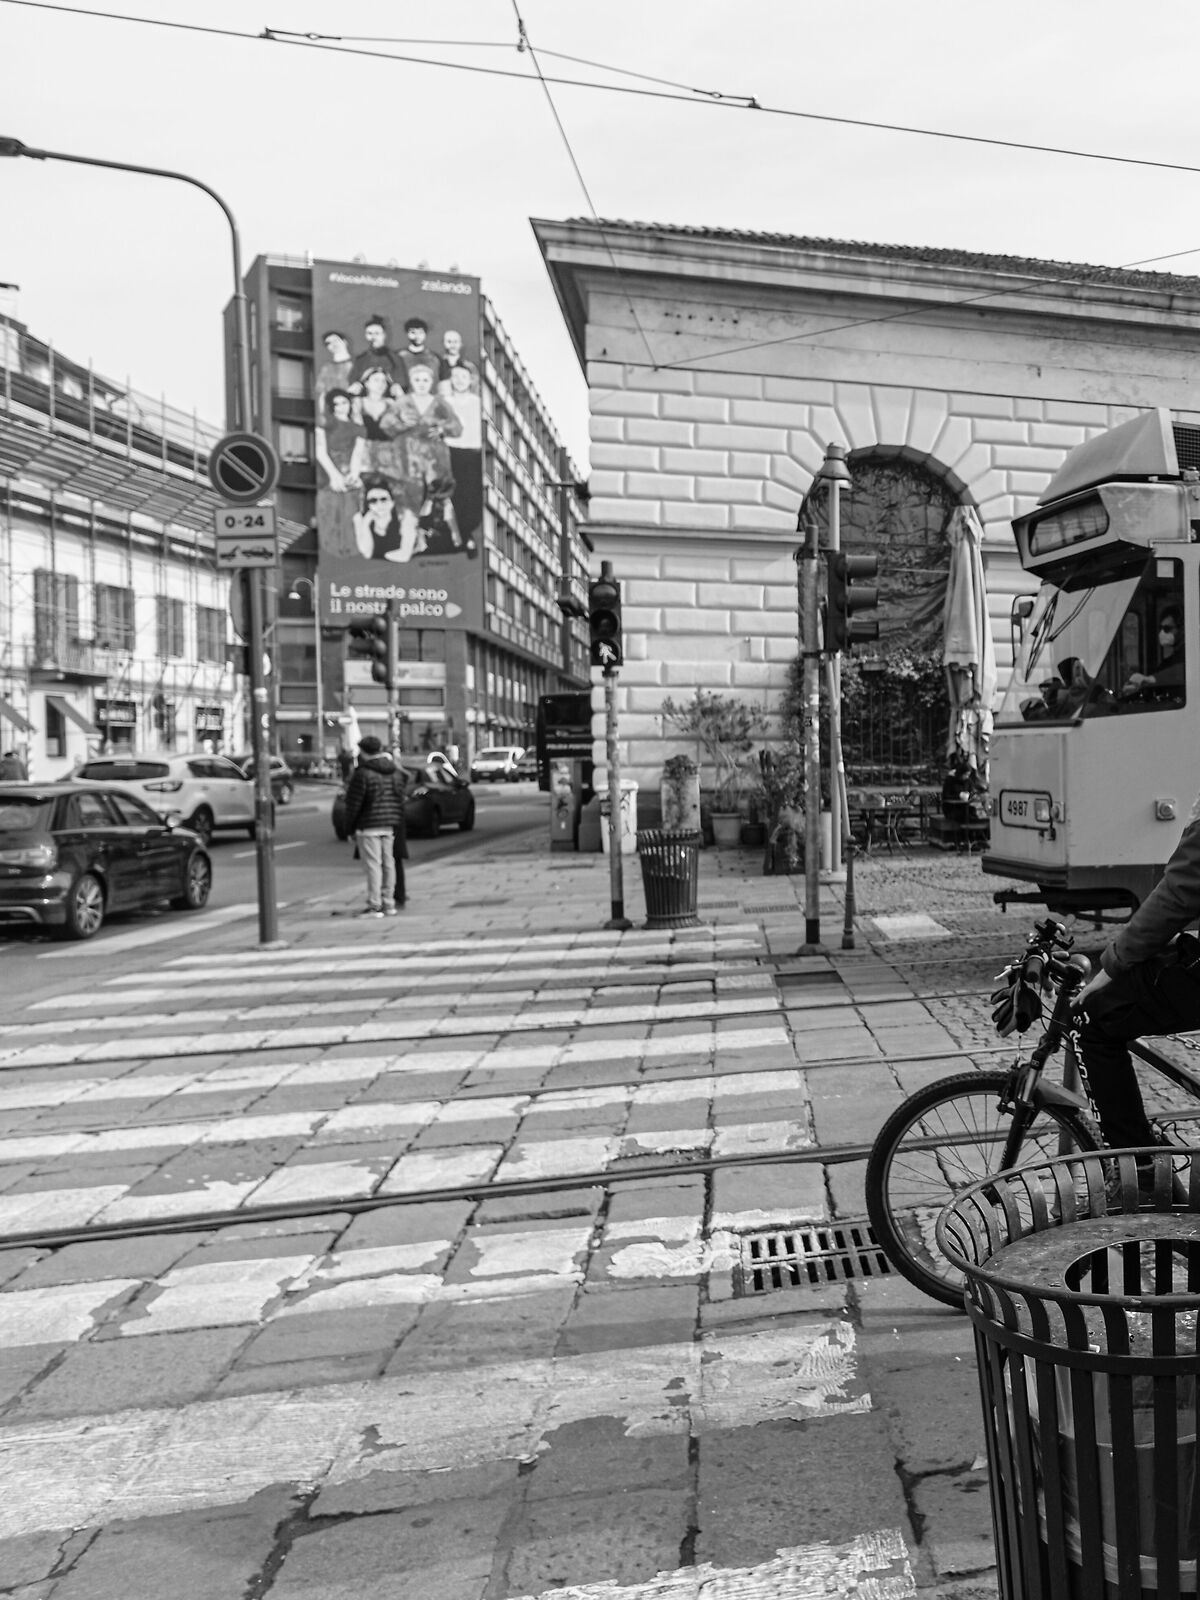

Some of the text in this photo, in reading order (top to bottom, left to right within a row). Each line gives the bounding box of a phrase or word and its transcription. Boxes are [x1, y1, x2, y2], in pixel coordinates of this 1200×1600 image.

[421, 279, 472, 295] zalando
[330, 582, 448, 601] Le strade sono
[330, 598, 444, 618] il nostr palco
[1007, 800, 1028, 816] 4987
